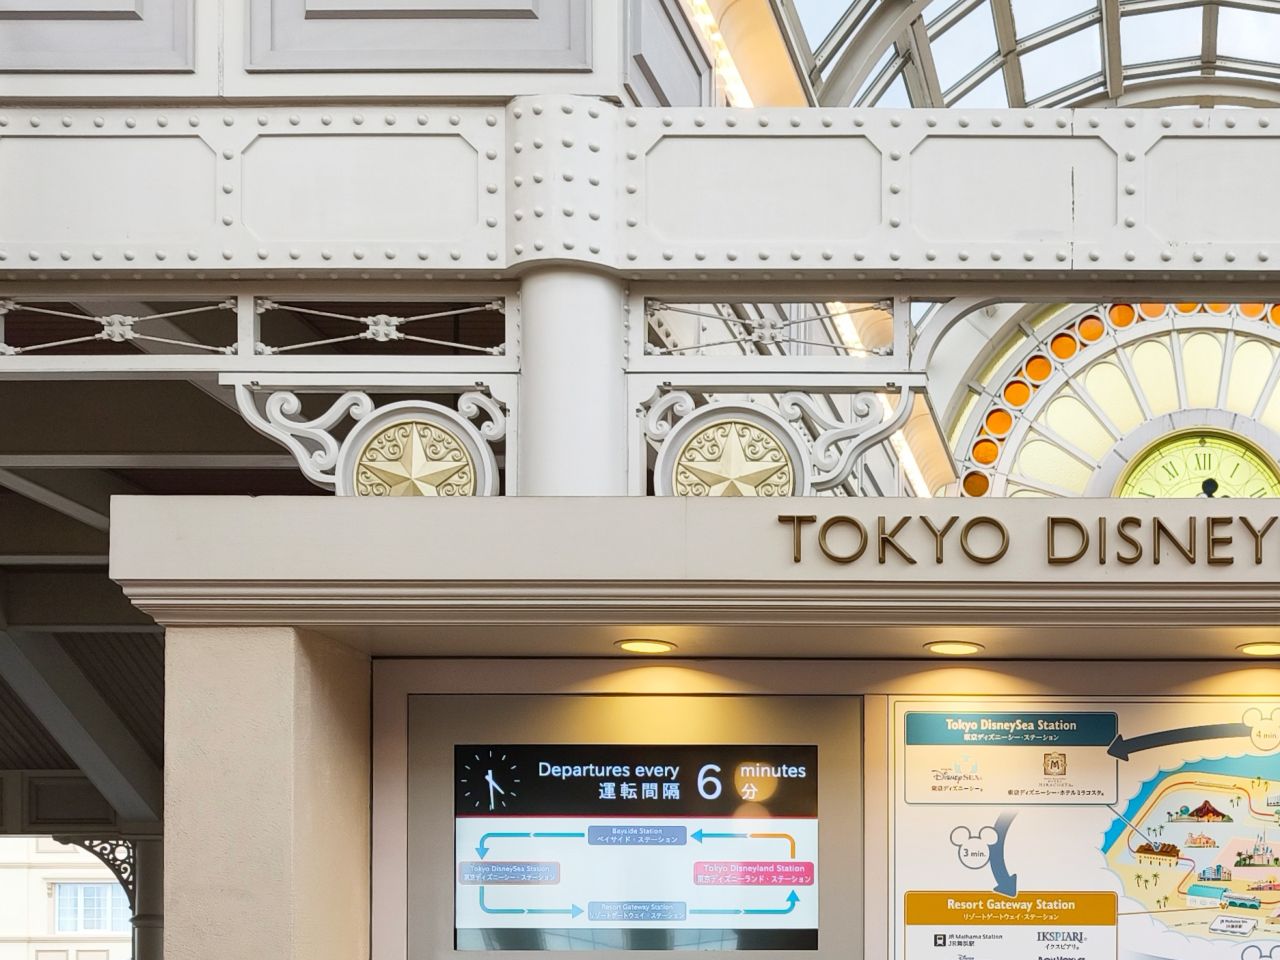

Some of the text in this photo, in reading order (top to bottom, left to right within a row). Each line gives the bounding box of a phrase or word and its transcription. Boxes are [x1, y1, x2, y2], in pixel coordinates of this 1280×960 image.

[778, 514, 1010, 565] TOKYO
[946, 719, 1077, 732] Tokyo DisneySea Station
[538, 762, 806, 800] Departures every 6 minutes
[598, 782, 758, 800] 運転間隔 分
[963, 848, 969, 857] 3
[703, 864, 805, 874] Tokyo Disneyland Station
[947, 898, 1075, 912] Resort Gateway Station
